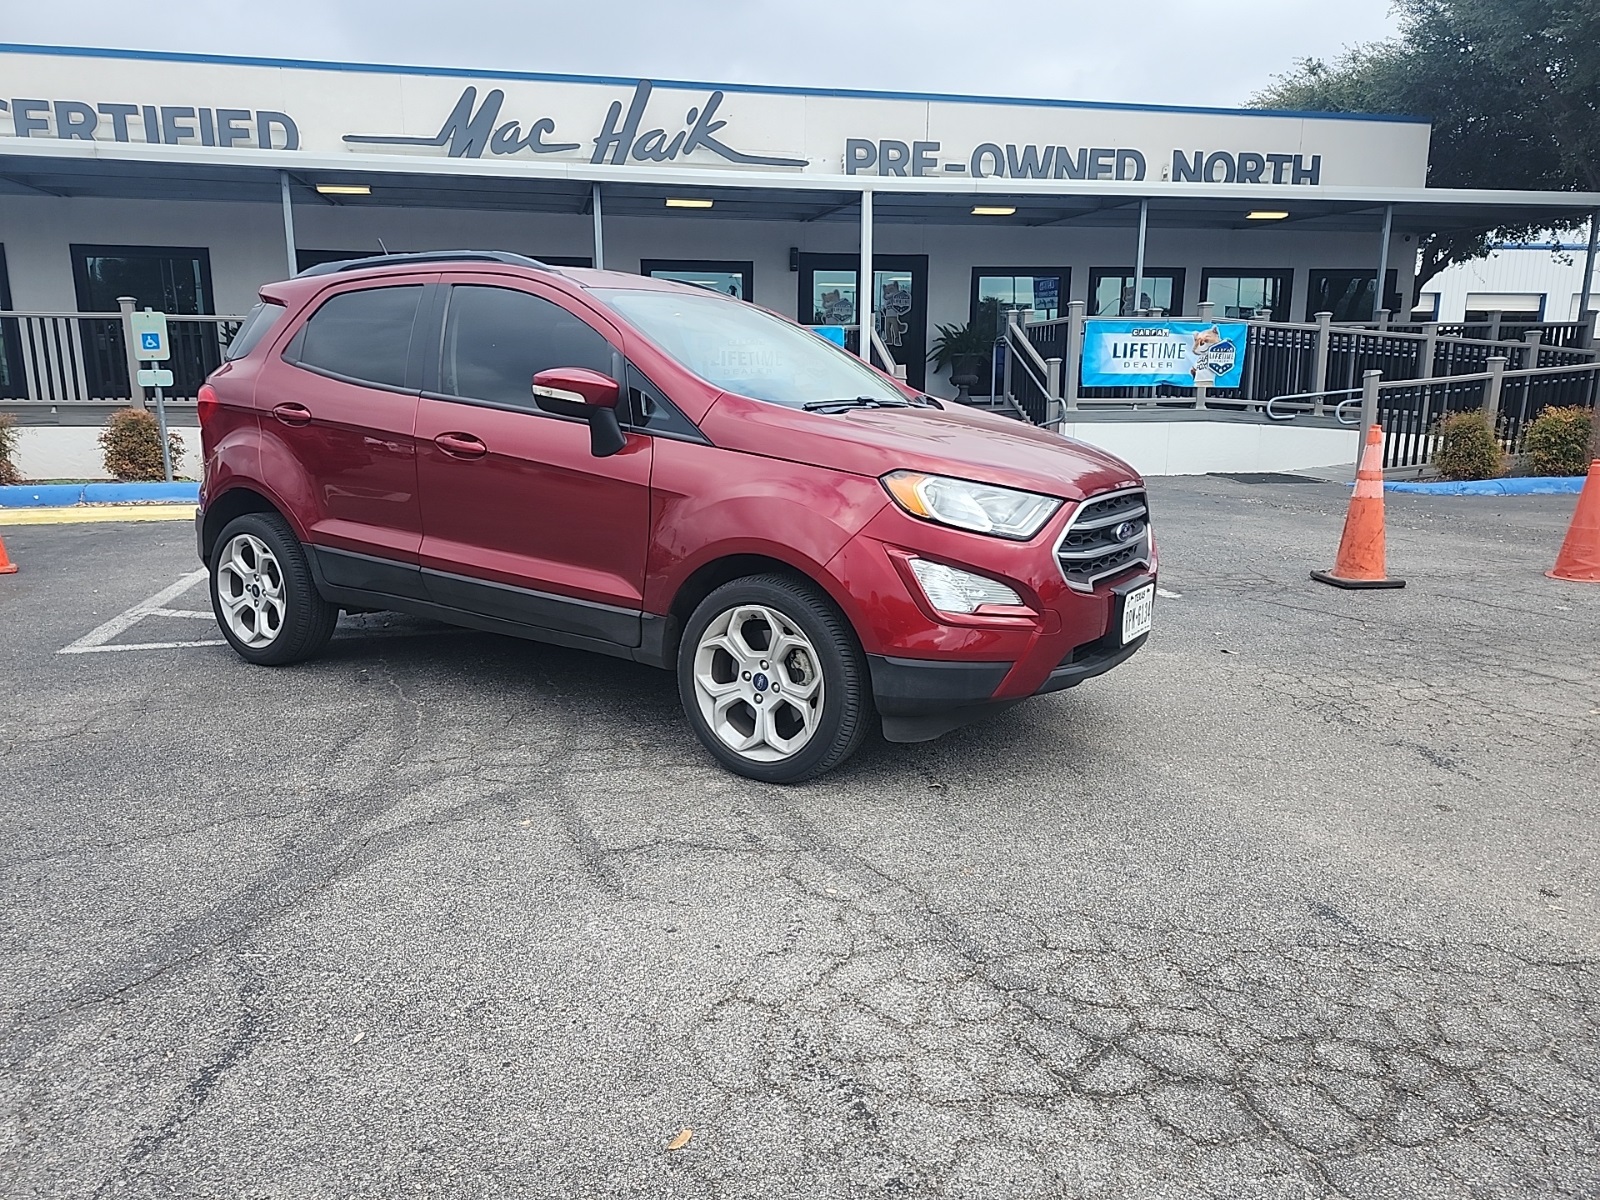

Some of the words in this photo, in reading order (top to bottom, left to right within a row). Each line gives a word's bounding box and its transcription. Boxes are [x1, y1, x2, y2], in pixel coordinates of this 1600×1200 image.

[0, 98, 300, 151] ERTIFIED
[342, 86, 580, 158] Mac
[590, 79, 809, 165] Haik
[846, 138, 1147, 182] PRE-OWNED
[1172, 149, 1322, 186] NORTH
[1131, 328, 1170, 337] CARFAX
[1112, 342, 1187, 359] LIFETIME
[1123, 361, 1173, 369] DEALER
